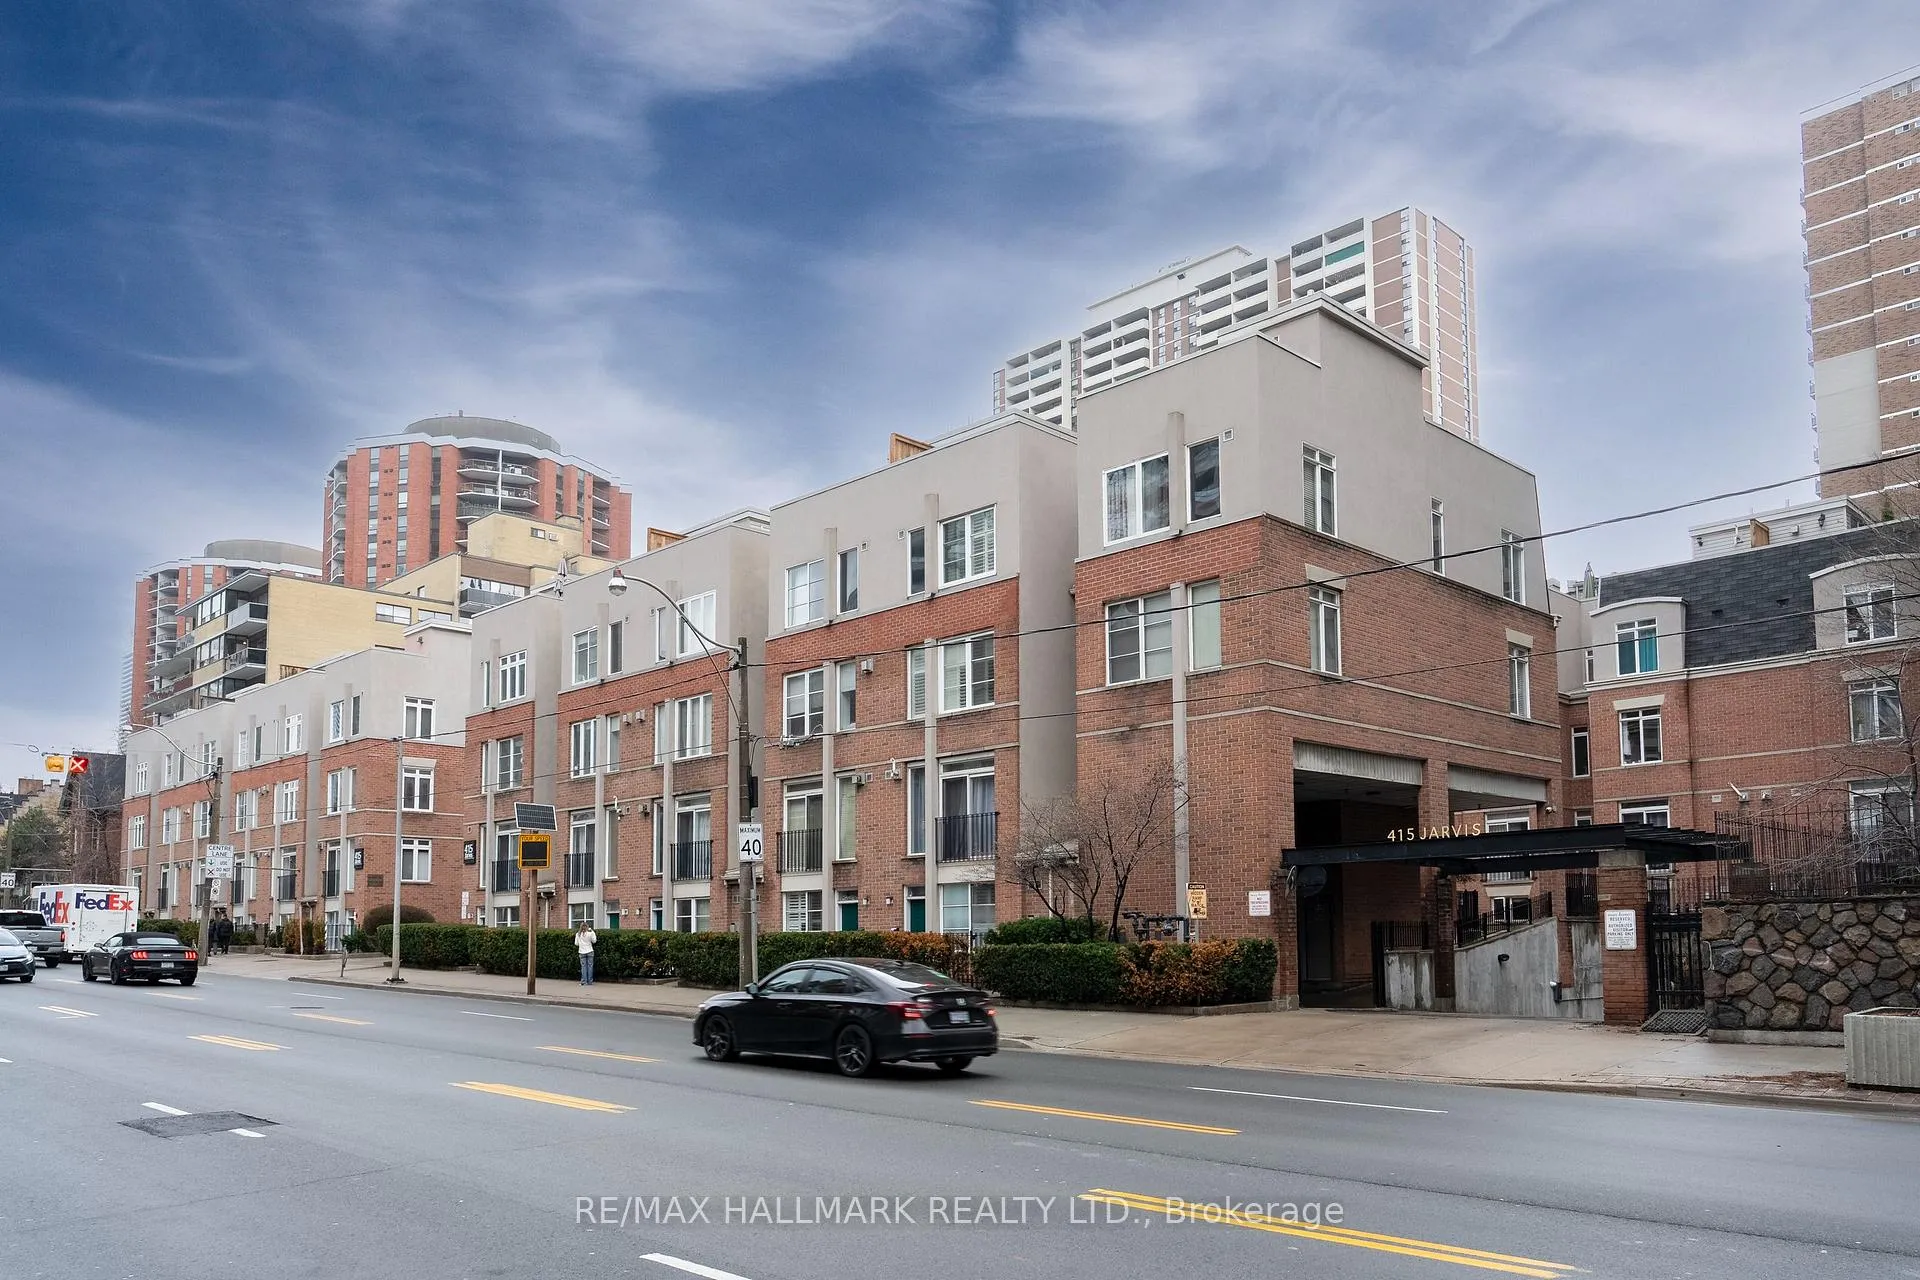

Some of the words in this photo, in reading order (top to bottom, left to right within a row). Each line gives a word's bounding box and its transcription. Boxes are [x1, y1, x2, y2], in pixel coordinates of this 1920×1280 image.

[1387, 827, 1415, 842] 415
[1420, 823, 1481, 840] JARVIS
[741, 839, 762, 856] 40
[1, 879, 14, 887] 40
[40, 891, 70, 924] FedEx
[75, 893, 134, 911] FedEx
